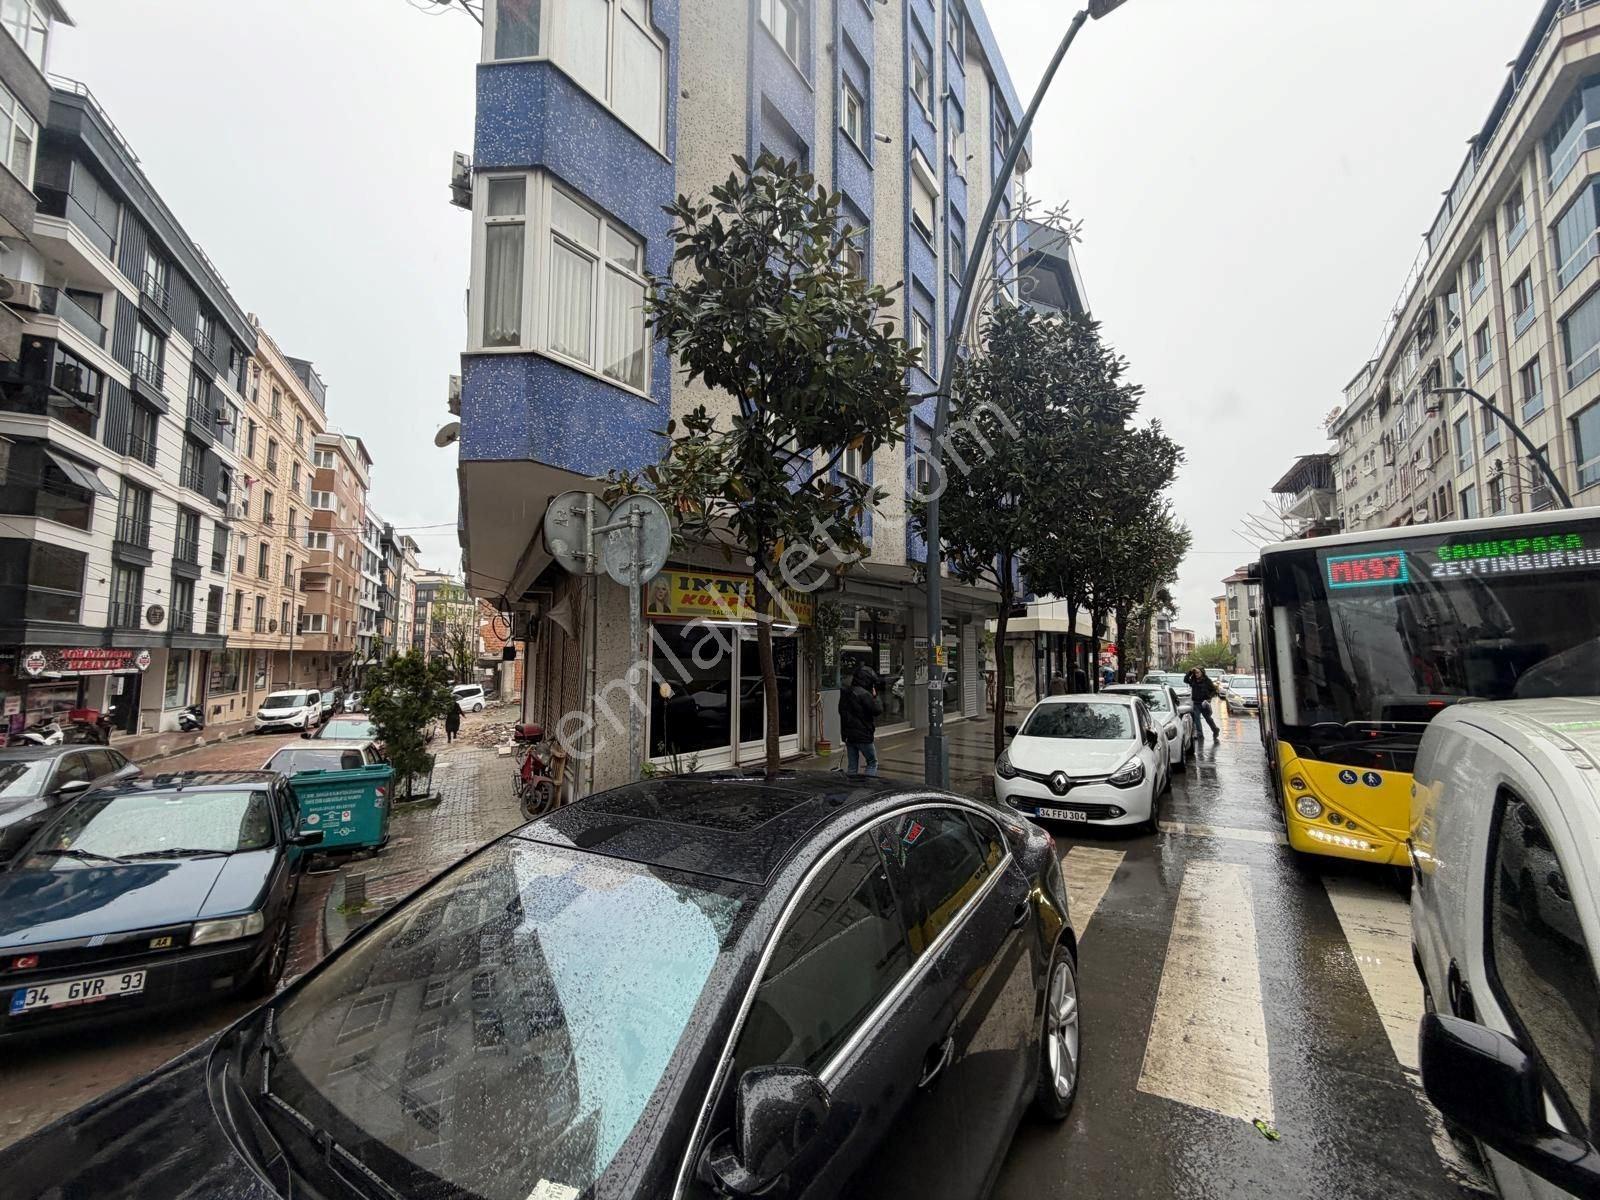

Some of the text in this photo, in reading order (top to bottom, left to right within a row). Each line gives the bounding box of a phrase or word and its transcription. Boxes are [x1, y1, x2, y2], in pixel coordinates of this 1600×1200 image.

[1330, 556, 1401, 582] MK97
[678, 576, 754, 594] INTE
[1040, 808, 1085, 821] 34 FFU 304
[26, 986, 50, 1006] 34
[68, 979, 105, 999] GVR
[120, 972, 143, 991] 93
